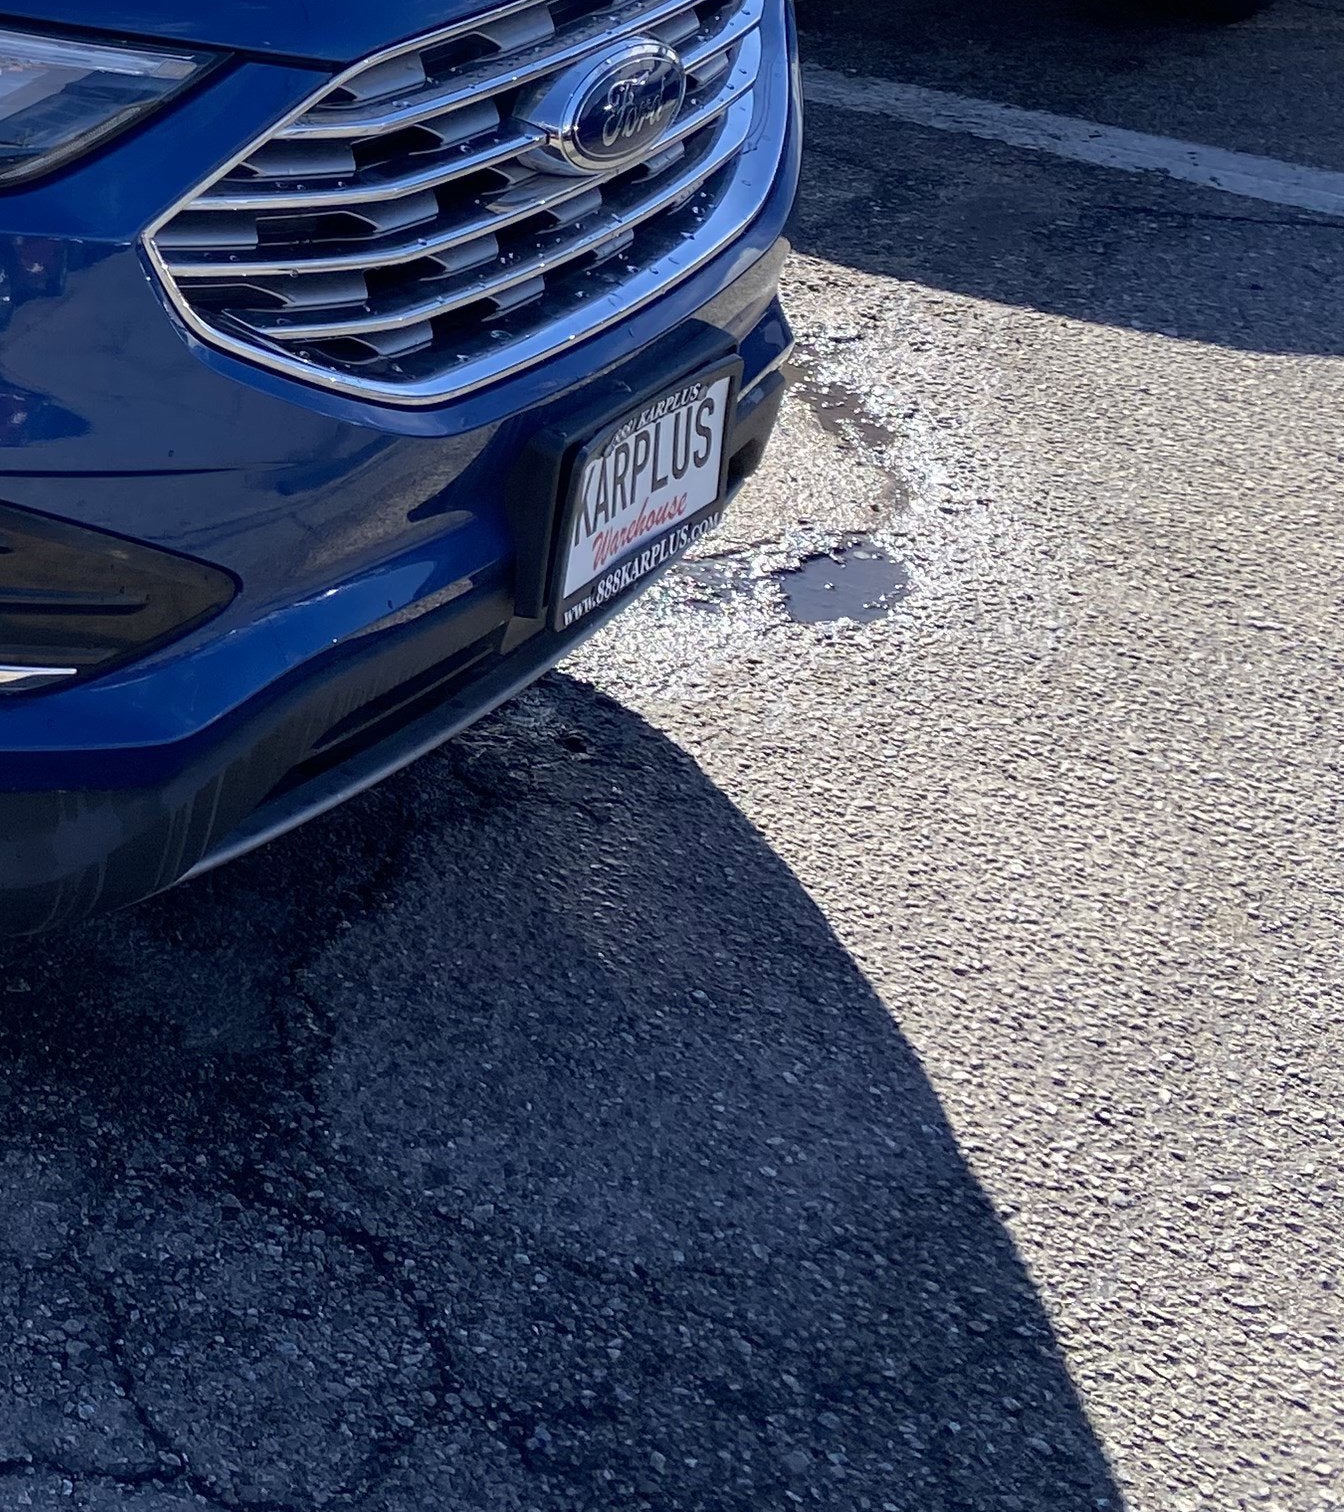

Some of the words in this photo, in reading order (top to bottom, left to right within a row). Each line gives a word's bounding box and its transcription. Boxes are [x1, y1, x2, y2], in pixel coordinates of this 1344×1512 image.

[602, 70, 665, 147] Ford
[636, 383, 701, 431] KARPLUS
[574, 397, 715, 548] KARPLUS
[592, 491, 689, 572] Warehouse
